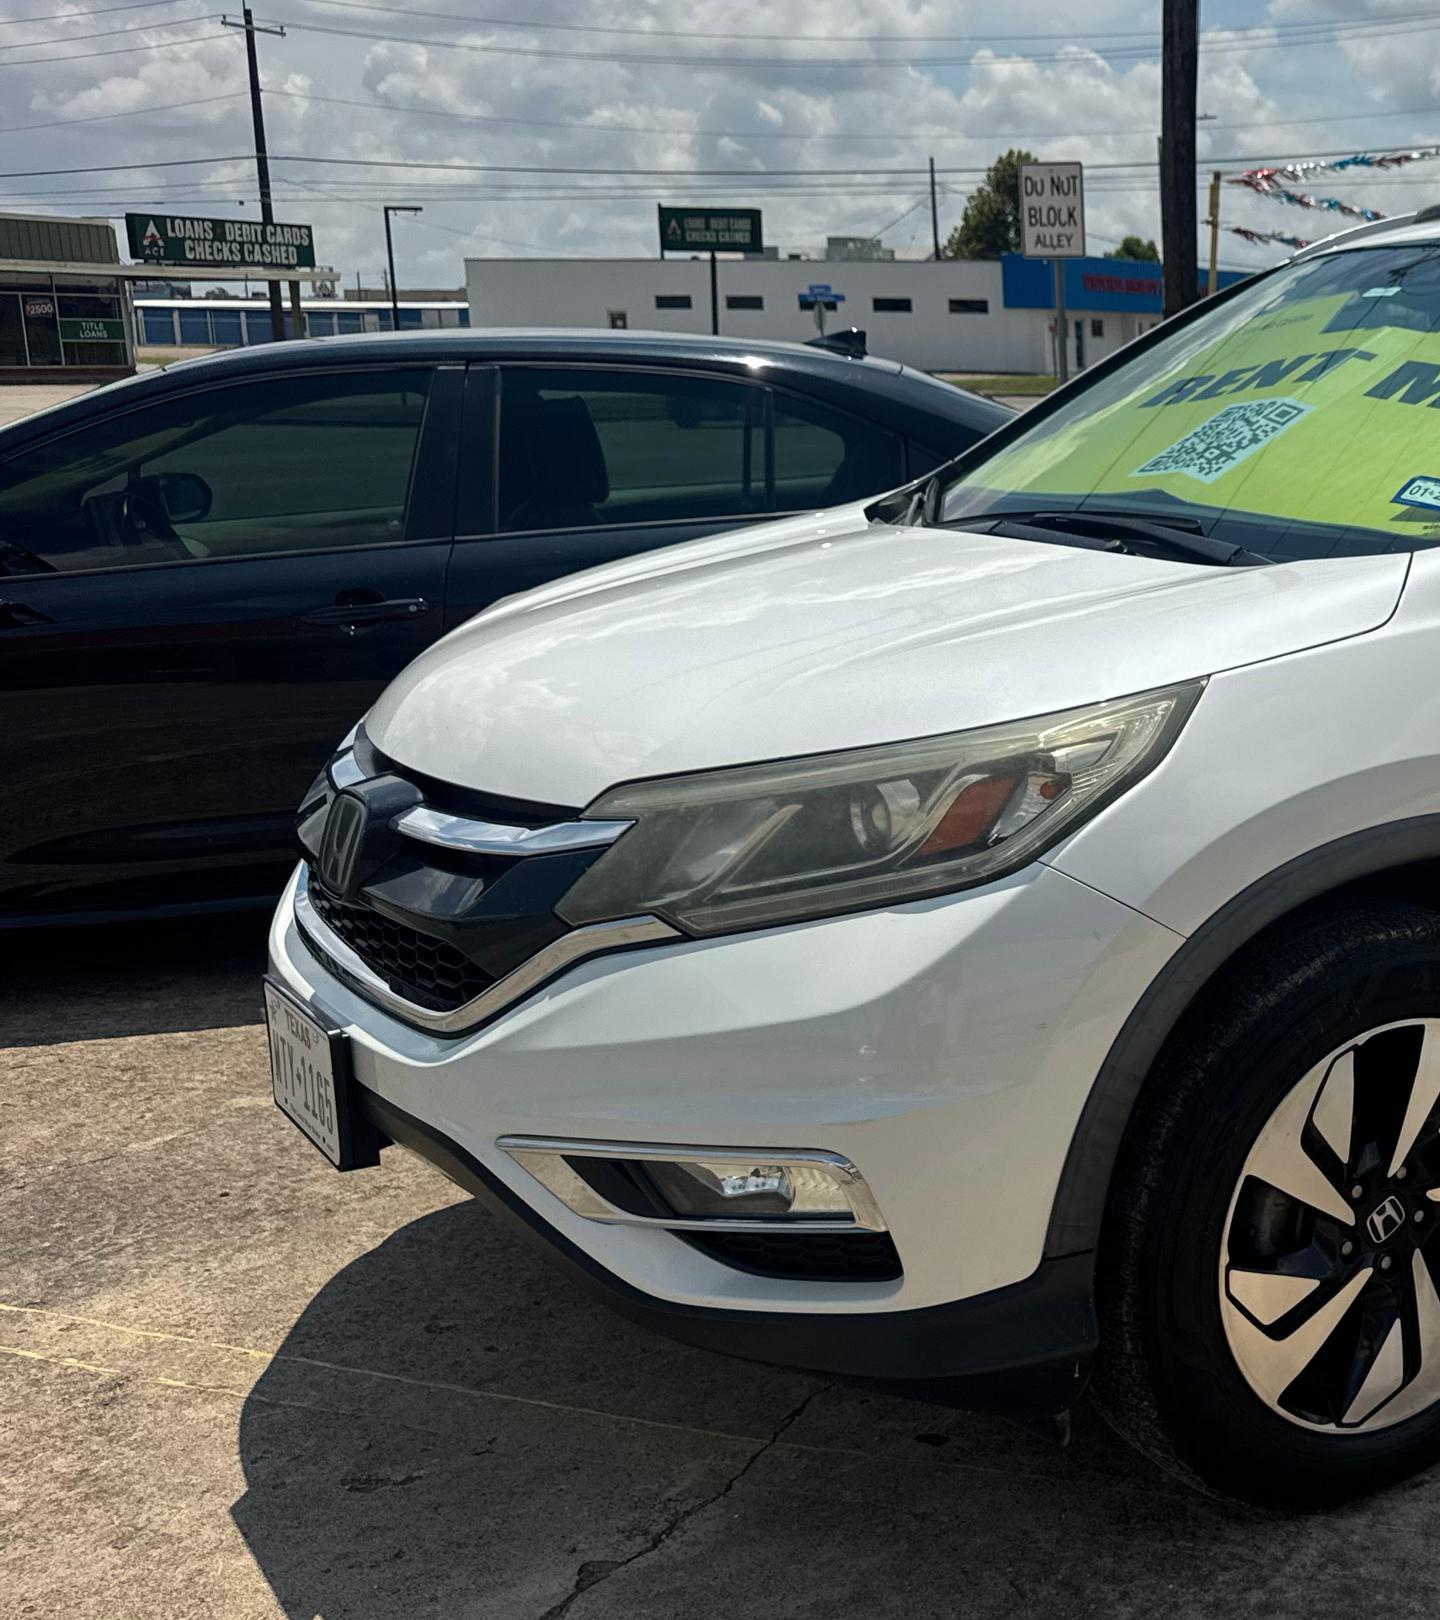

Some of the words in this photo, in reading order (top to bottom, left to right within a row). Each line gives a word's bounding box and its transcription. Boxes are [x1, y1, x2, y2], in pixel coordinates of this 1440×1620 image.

[1024, 176, 1045, 197] DO
[1050, 175, 1079, 197] NOT
[1028, 206, 1078, 227] BLOCK
[166, 218, 213, 240] LOANS
[224, 221, 263, 243] DEBIT
[266, 225, 309, 246] CARDS
[1034, 233, 1074, 249] ALLEY
[144, 247, 165, 257] ACE
[184, 239, 241, 262] CHECKS
[244, 243, 298, 265] CASHED
[80, 330, 108, 338] LOANS
[81, 322, 104, 330] TITLE
[1137, 347, 1378, 409] RENT
[284, 1007, 312, 1050] TEXAS
